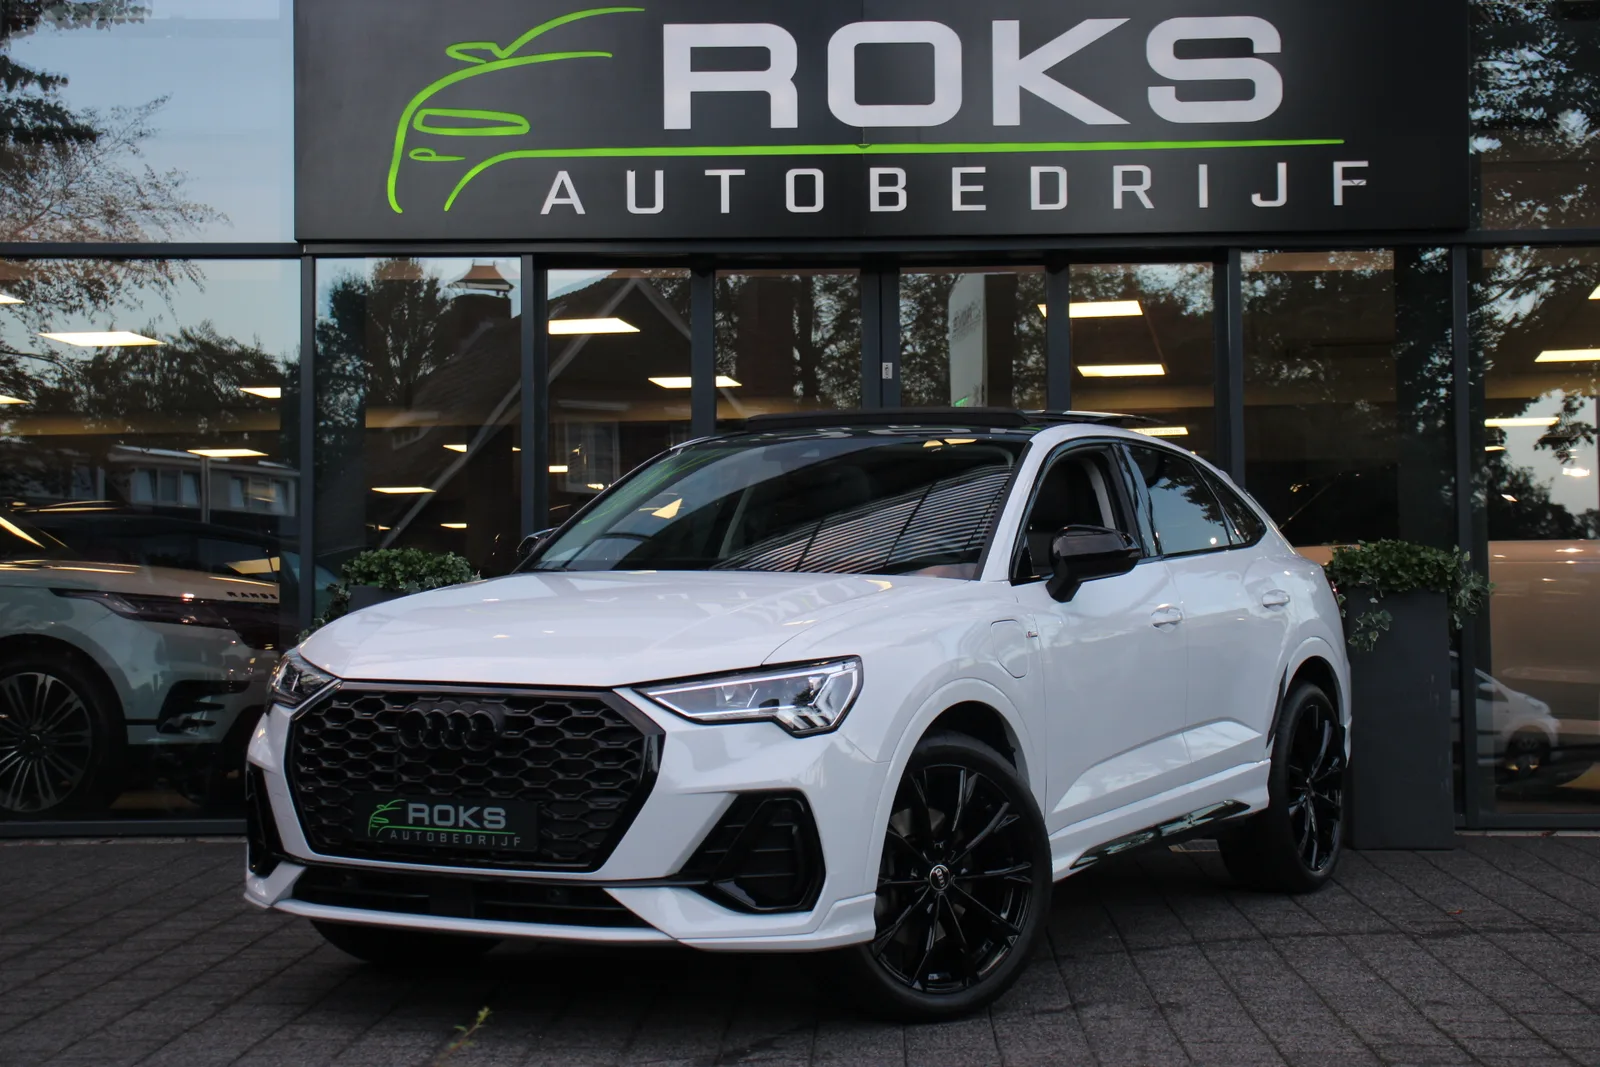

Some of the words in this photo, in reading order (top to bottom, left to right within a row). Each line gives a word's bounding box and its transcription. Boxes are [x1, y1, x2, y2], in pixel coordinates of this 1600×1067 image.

[663, 16, 1283, 130] ROKS
[540, 161, 1369, 215] AUTOBEDRIJF
[408, 803, 506, 829] ROKS
[390, 830, 521, 847] AUTOBEDRIJF
